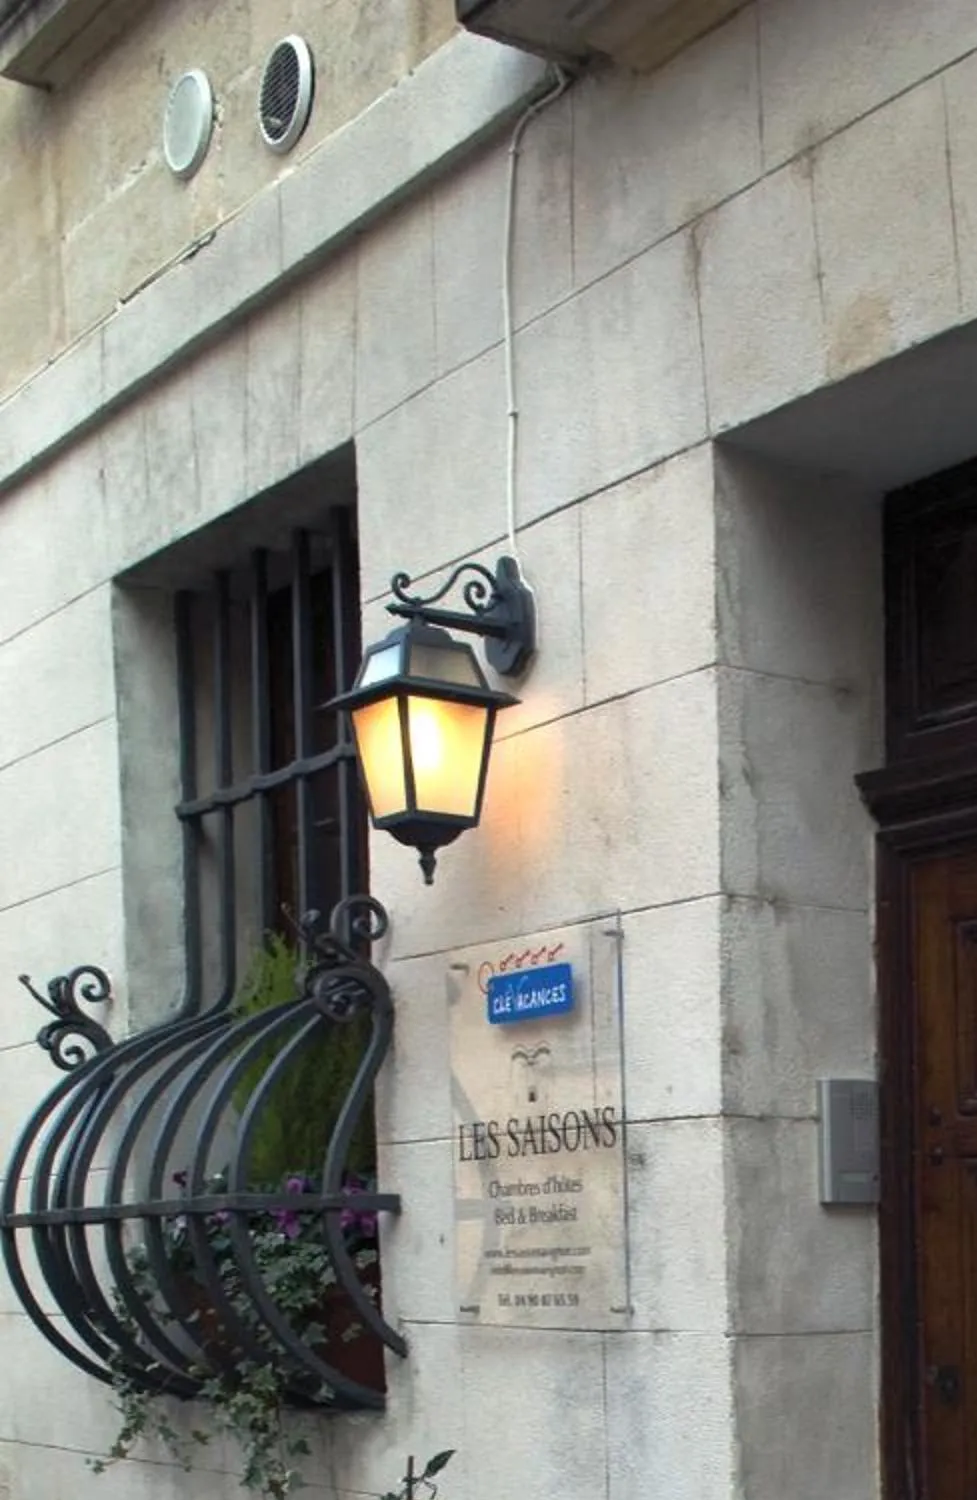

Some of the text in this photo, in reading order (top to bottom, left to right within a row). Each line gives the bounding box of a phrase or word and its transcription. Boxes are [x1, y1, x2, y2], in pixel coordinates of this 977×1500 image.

[459, 1106, 617, 1161] LES SAISONS
[488, 1177, 540, 1198] Chambres
[495, 1206, 515, 1225] Bed
[529, 1204, 578, 1222] Breakfast
